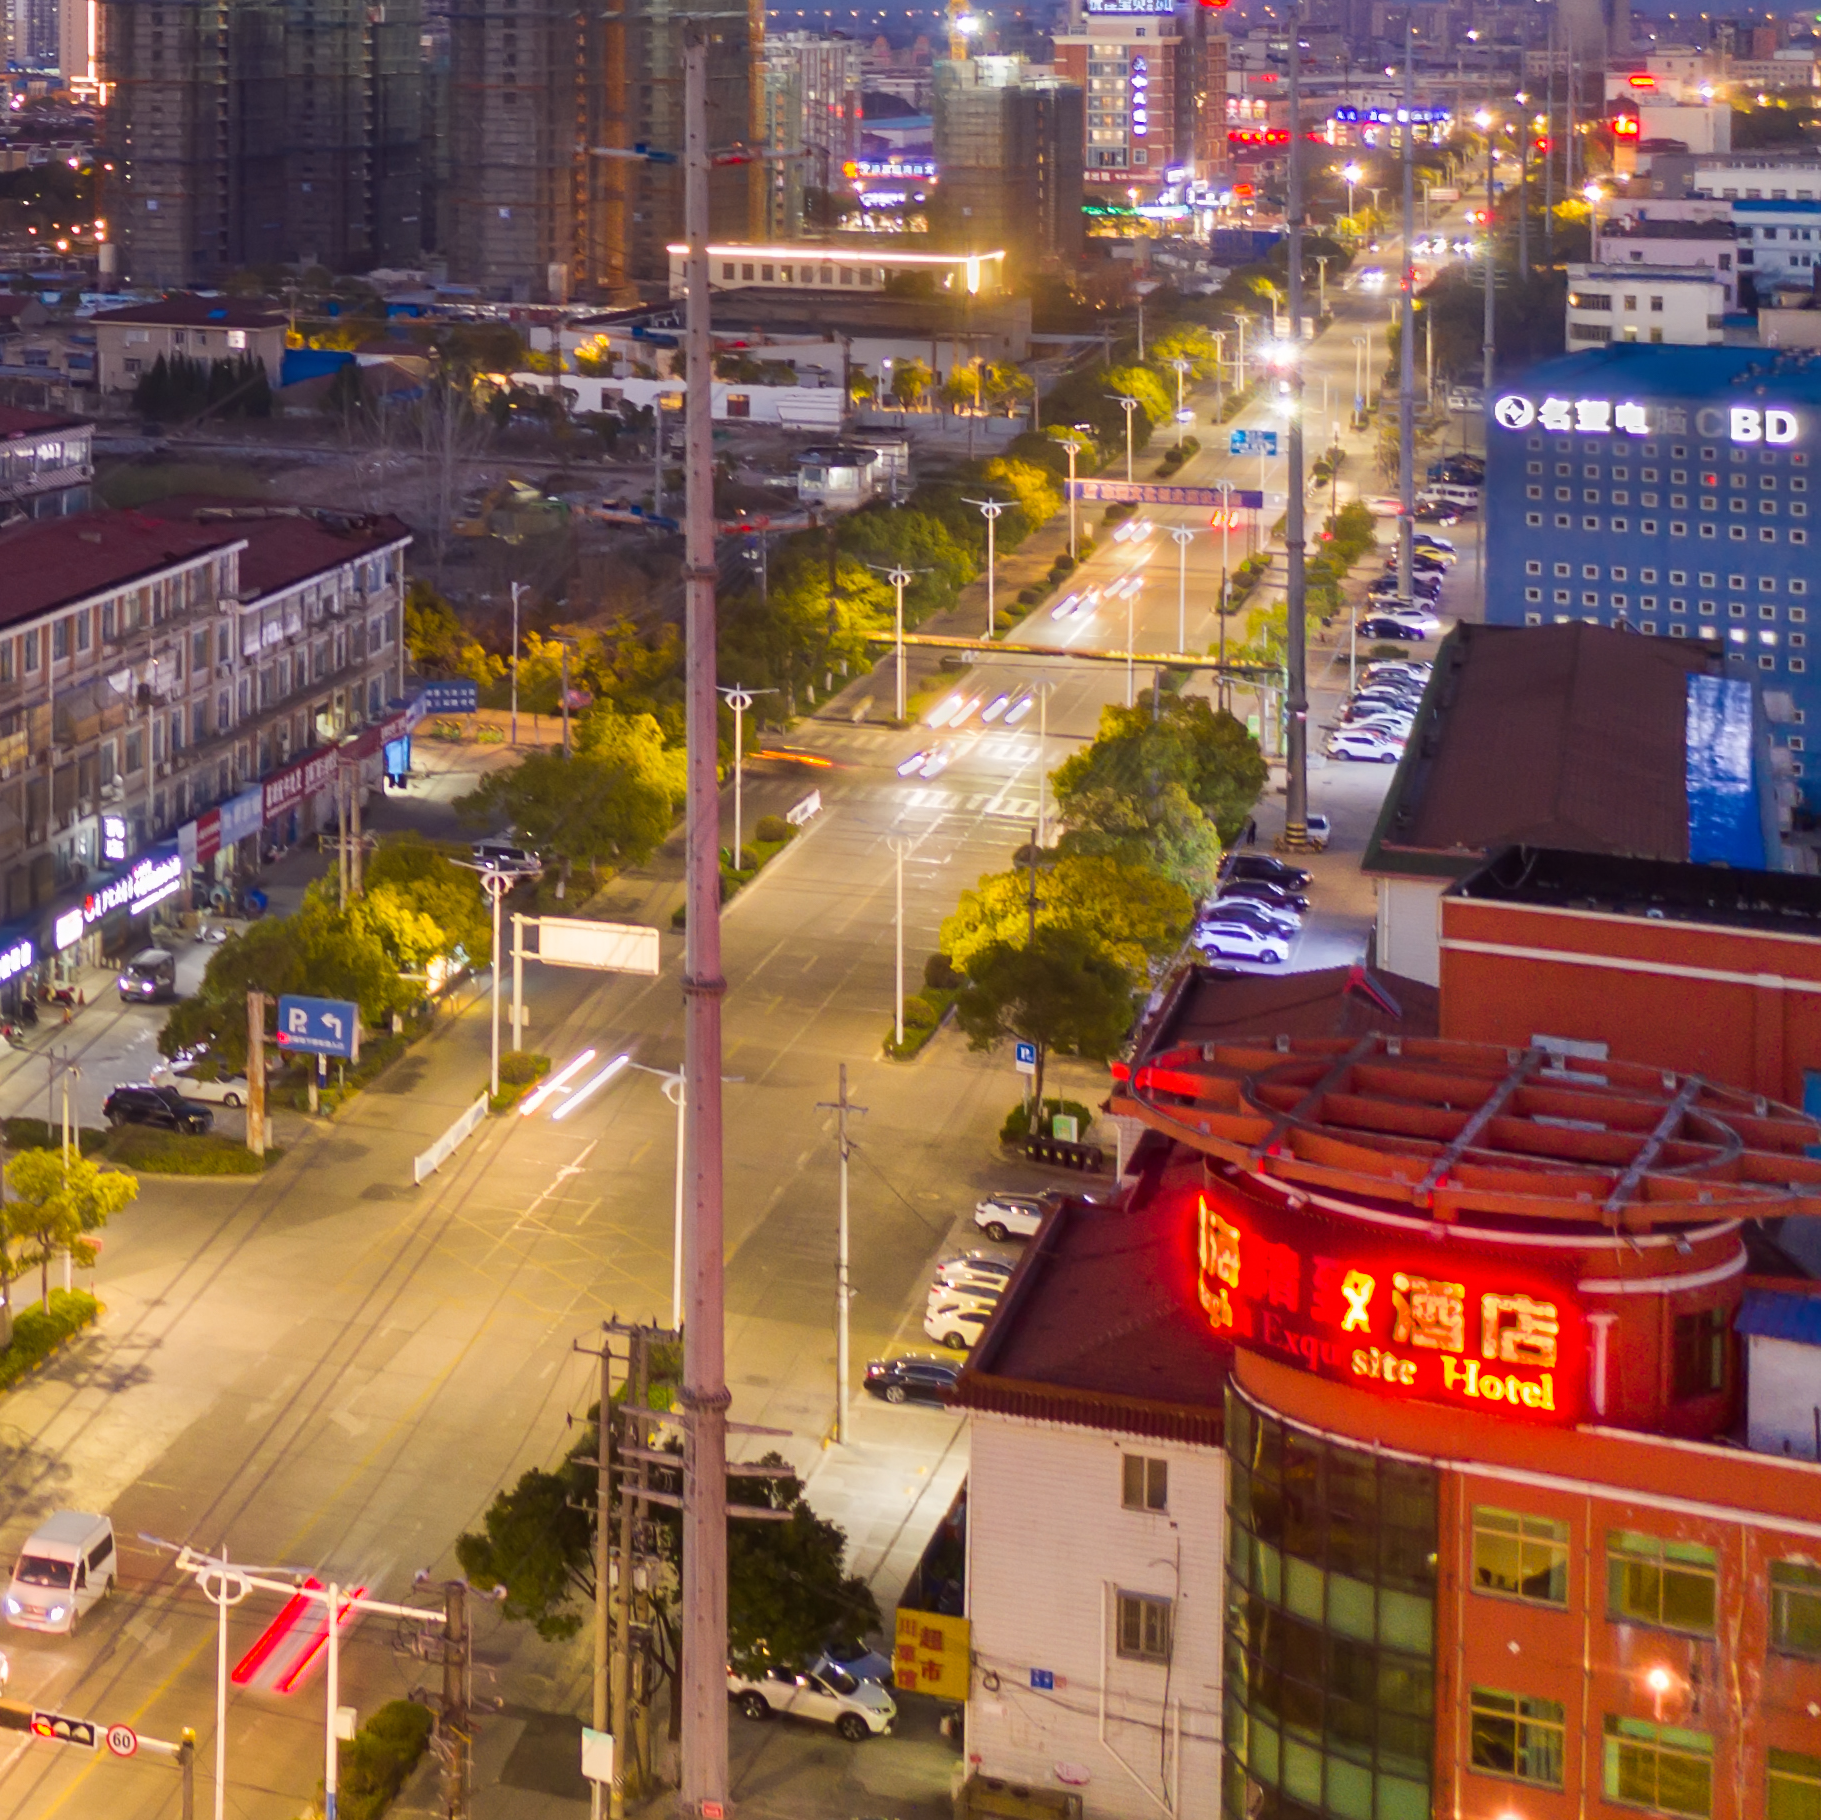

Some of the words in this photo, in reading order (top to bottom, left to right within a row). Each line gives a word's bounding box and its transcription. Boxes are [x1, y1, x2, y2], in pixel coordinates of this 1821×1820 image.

[1262, 1310, 1417, 1385] Exqusite
[1441, 1354, 1556, 1411] Hotel
[112, 1732, 131, 1749] 60
